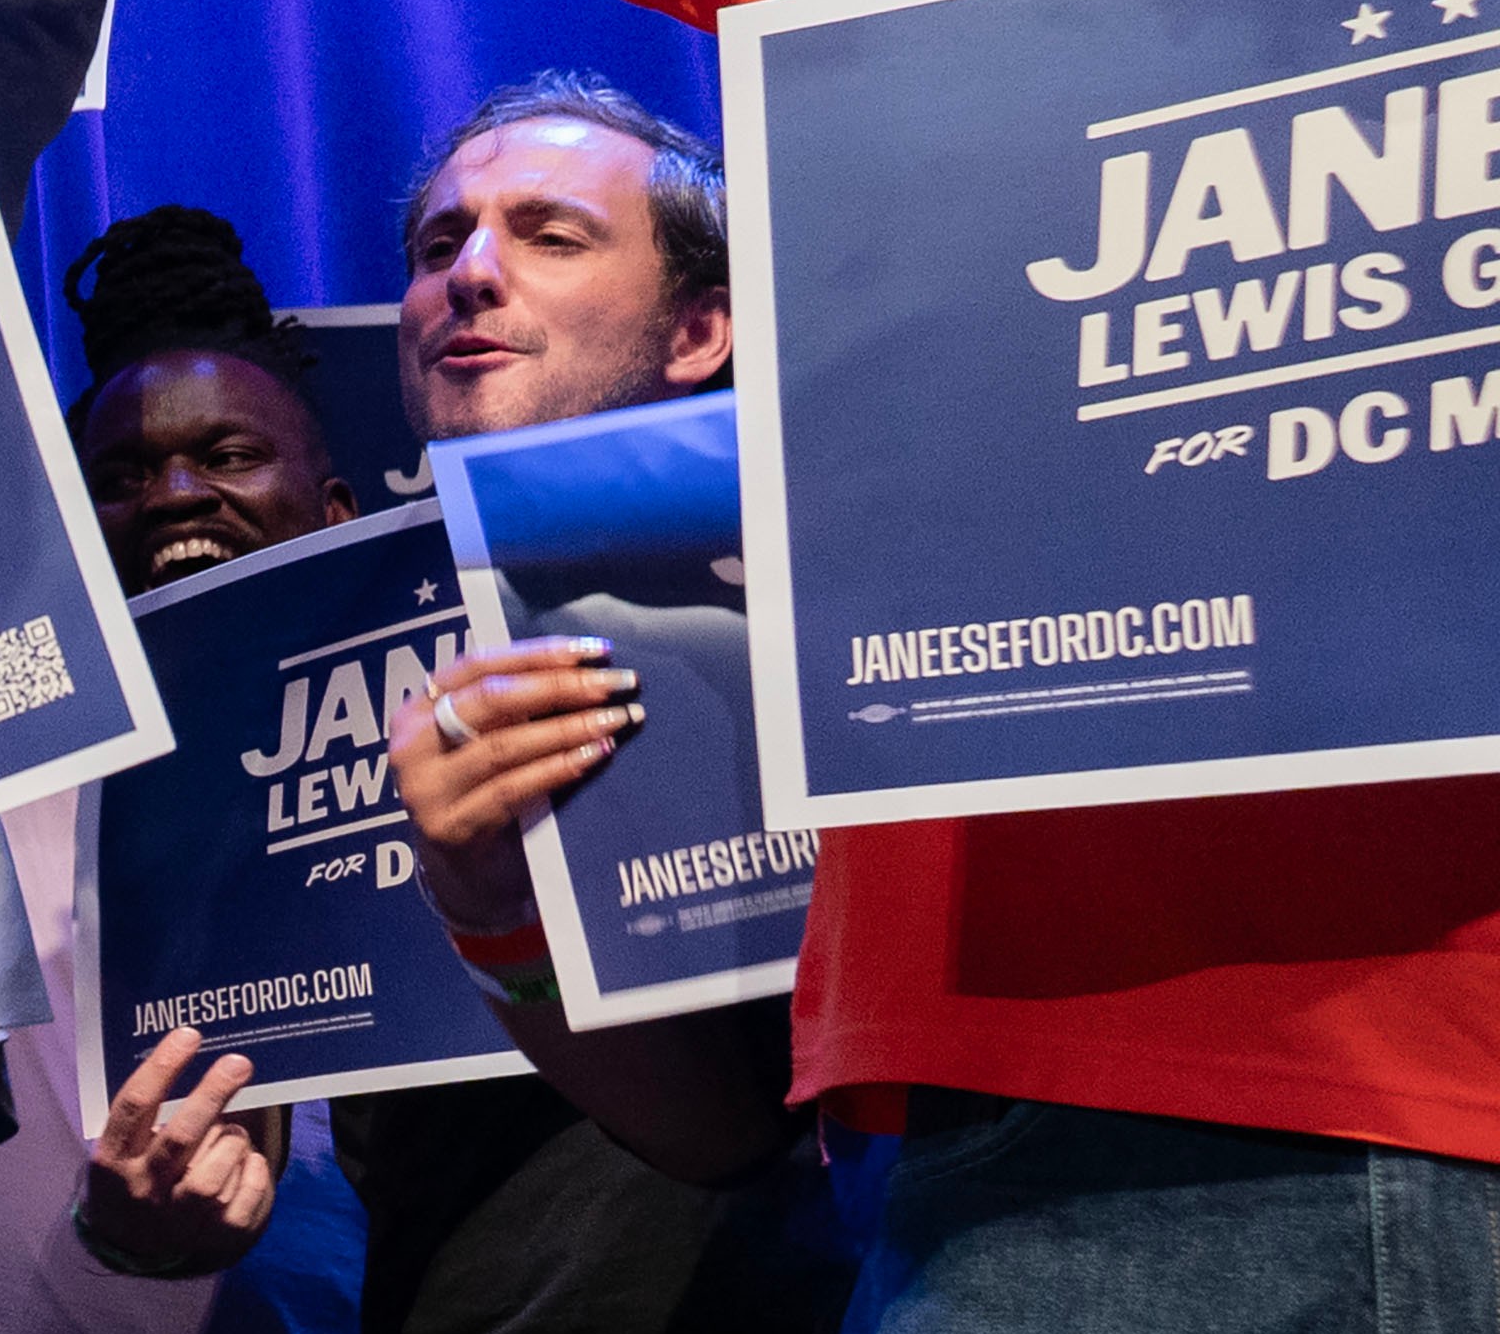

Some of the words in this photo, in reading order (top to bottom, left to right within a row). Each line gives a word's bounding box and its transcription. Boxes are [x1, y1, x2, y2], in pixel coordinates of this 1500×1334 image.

[1025, 67, 1500, 303] JANE
[1078, 252, 1409, 388] LEWIS
[1144, 424, 1252, 474] FOR
[1267, 392, 1411, 482] DC
[846, 594, 1254, 686] JANEESEFORDC.COM
[267, 752, 400, 833] LEW
[305, 853, 366, 888] FOR
[376, 839, 415, 889] D
[132, 963, 373, 1037] JANEESEFORDC.COM
